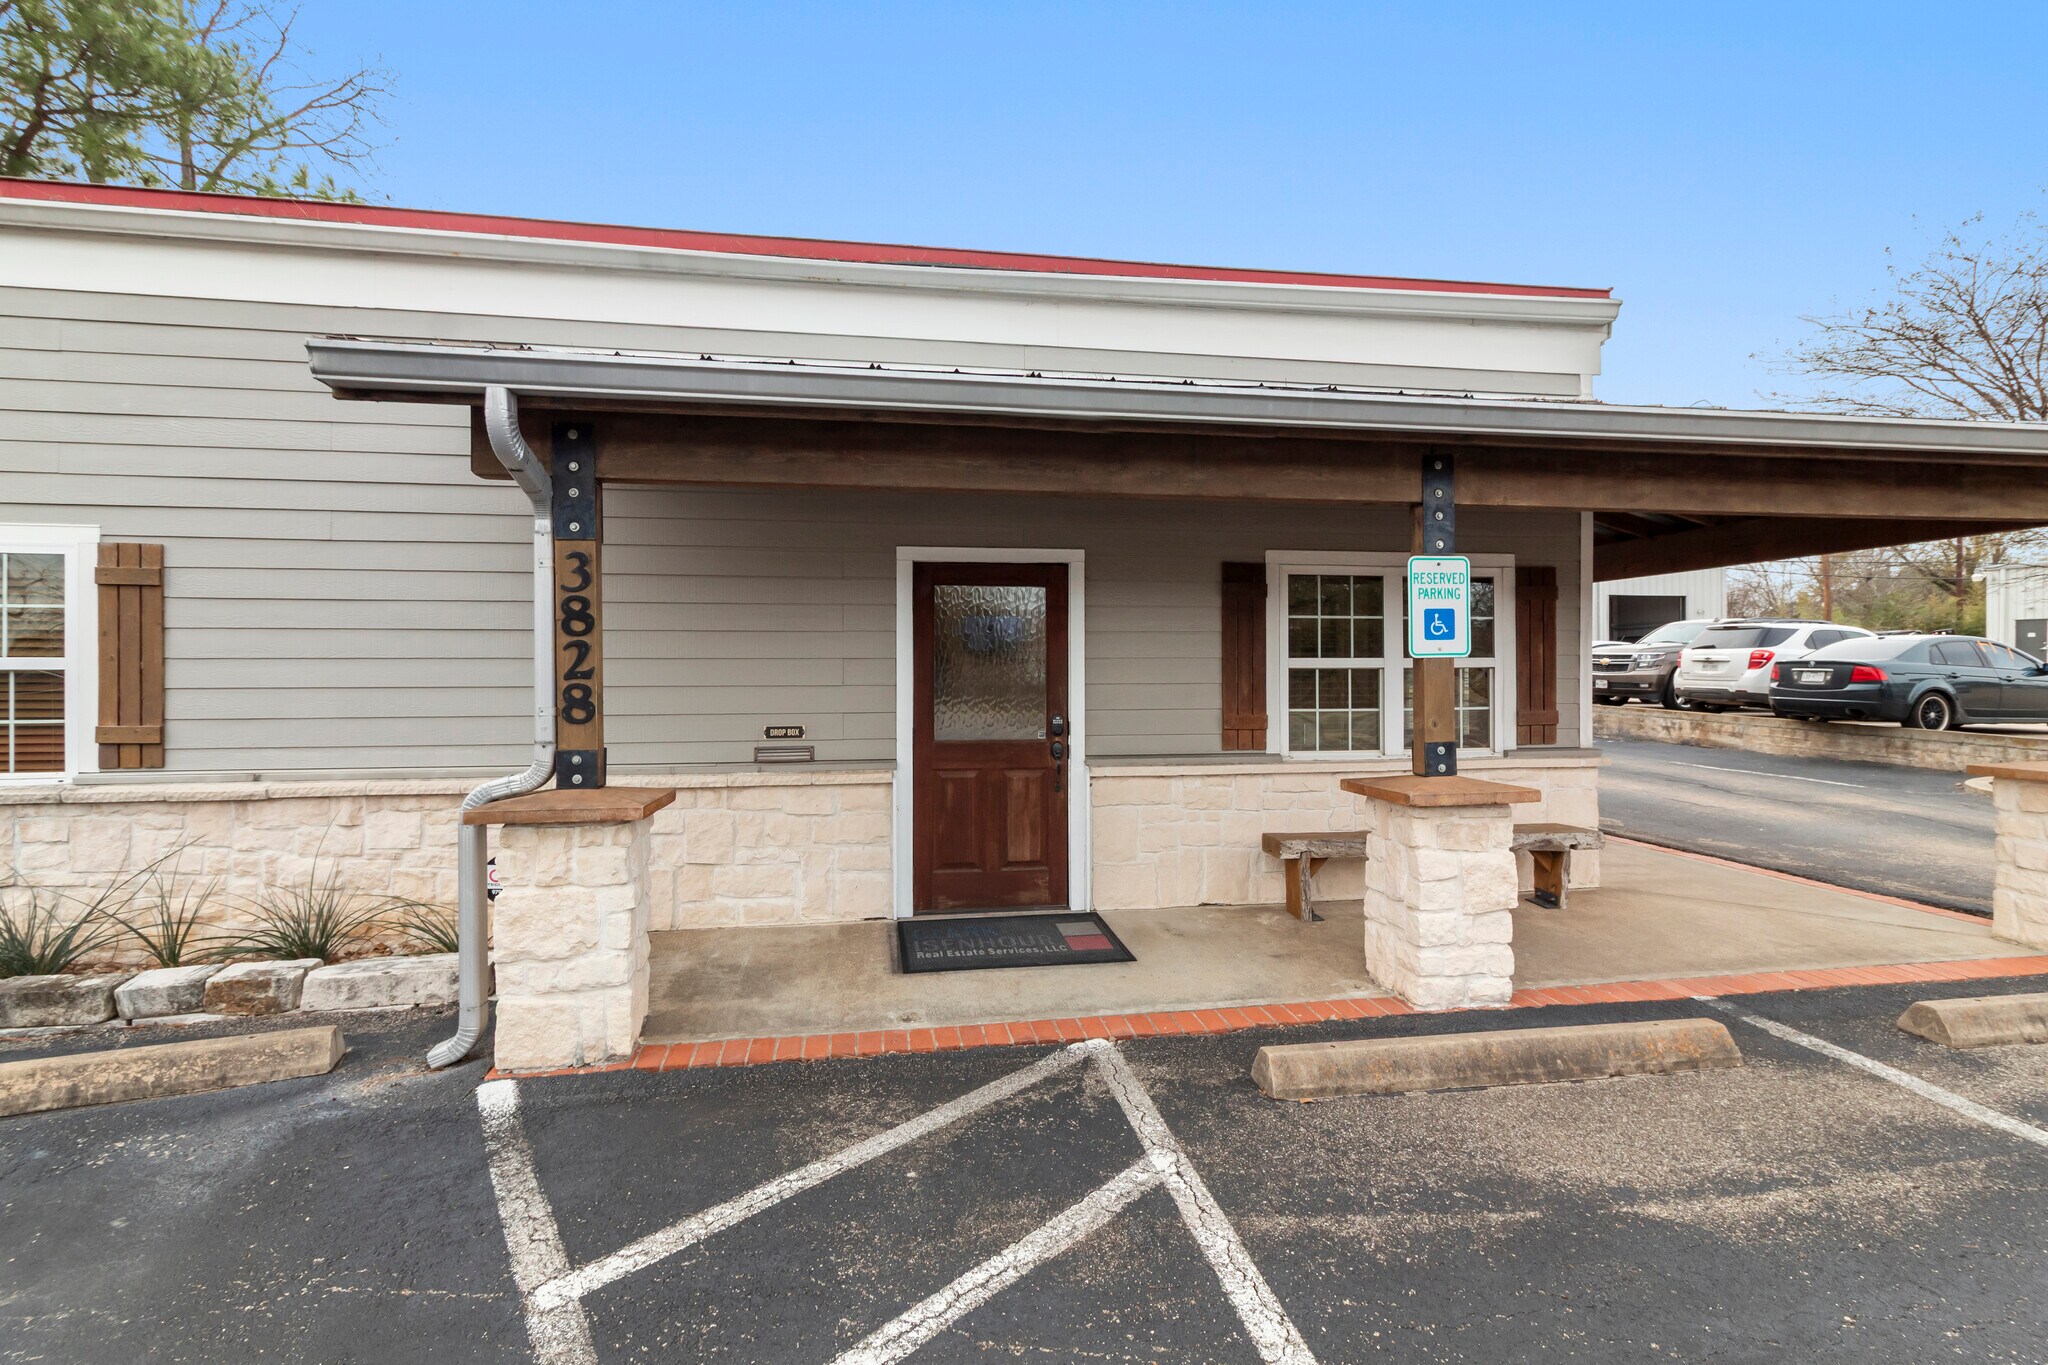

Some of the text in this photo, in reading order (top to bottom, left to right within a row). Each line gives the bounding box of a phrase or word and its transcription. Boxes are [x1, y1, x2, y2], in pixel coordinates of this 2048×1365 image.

[1413, 572, 1465, 585] RESERVED
[1418, 587, 1461, 600] PARKING
[560, 551, 596, 725] 3828
[914, 934, 1056, 951] ISENHOUR
[916, 944, 1068, 959] Real Estate Services, LLC
